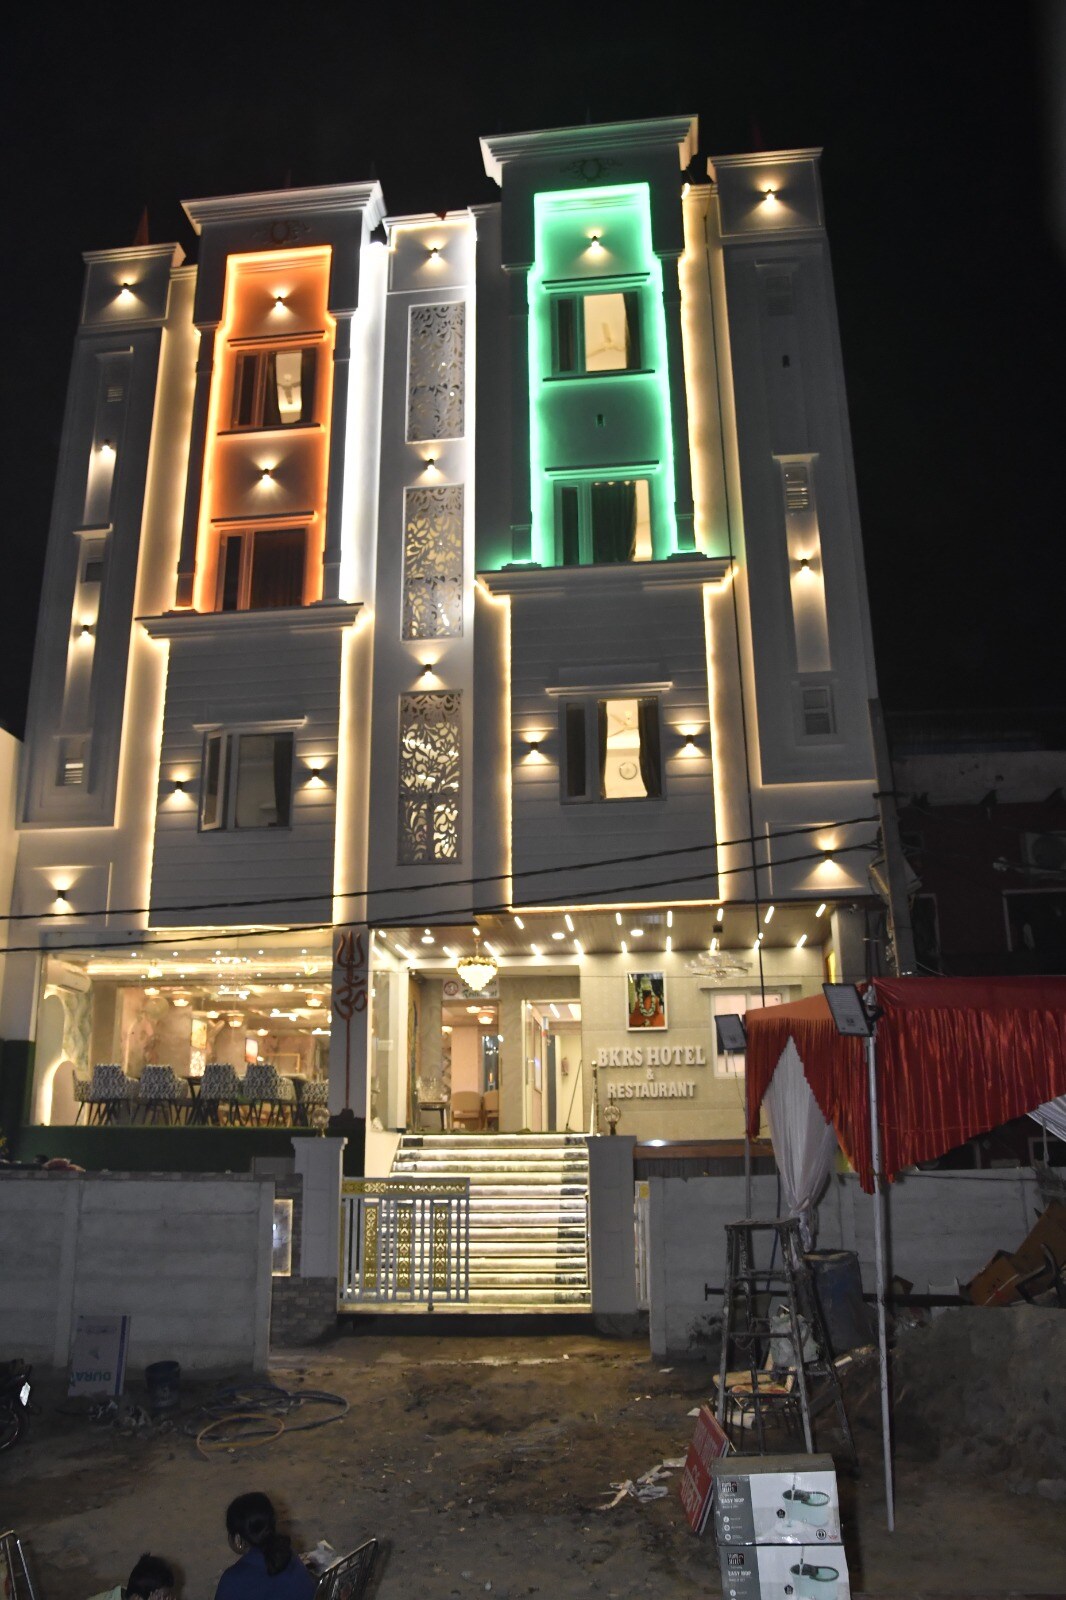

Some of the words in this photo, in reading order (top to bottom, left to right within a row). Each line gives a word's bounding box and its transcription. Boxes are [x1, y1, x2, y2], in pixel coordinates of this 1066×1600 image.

[597, 1047, 643, 1067] BKRS
[647, 1045, 706, 1066] HOTEL
[646, 1068, 655, 1080] &
[607, 1081, 696, 1098] RESTAURANT
